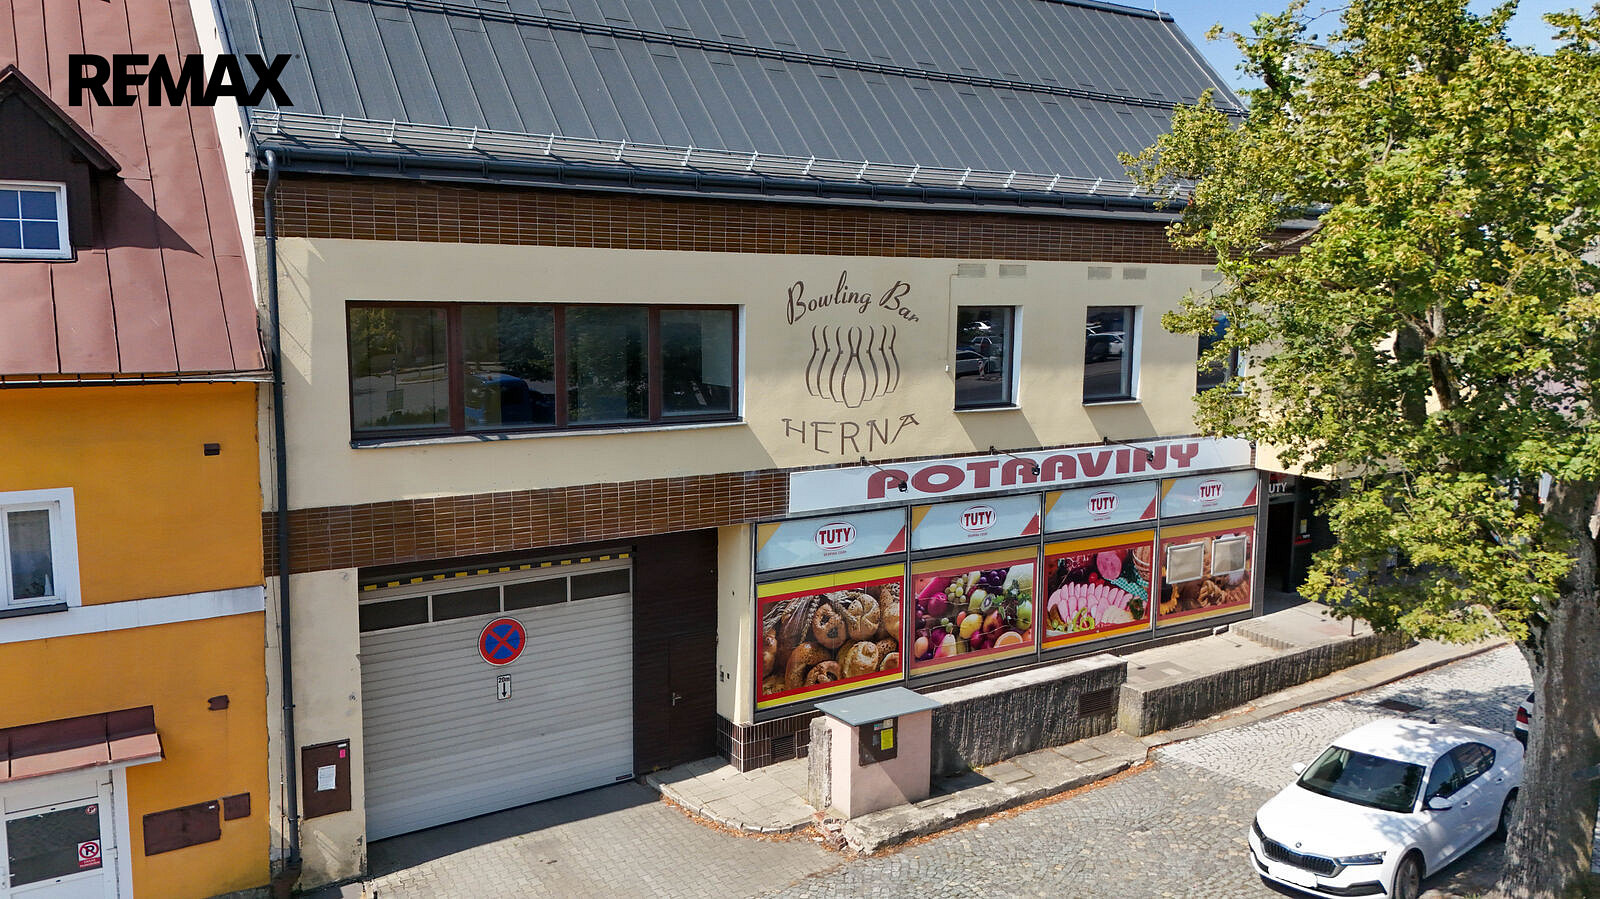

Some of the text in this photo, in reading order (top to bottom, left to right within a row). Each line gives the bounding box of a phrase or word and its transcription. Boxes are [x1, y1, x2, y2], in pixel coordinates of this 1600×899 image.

[787, 270, 920, 325] Bowling Bar
[781, 413, 920, 455] HERNA
[867, 442, 1199, 500] POTRAVINY
[1200, 484, 1221, 498] TUTY
[1268, 482, 1288, 494] UTY
[1090, 496, 1115, 511] TUTY
[964, 511, 992, 527] TUTY
[819, 527, 851, 545] TUTY
